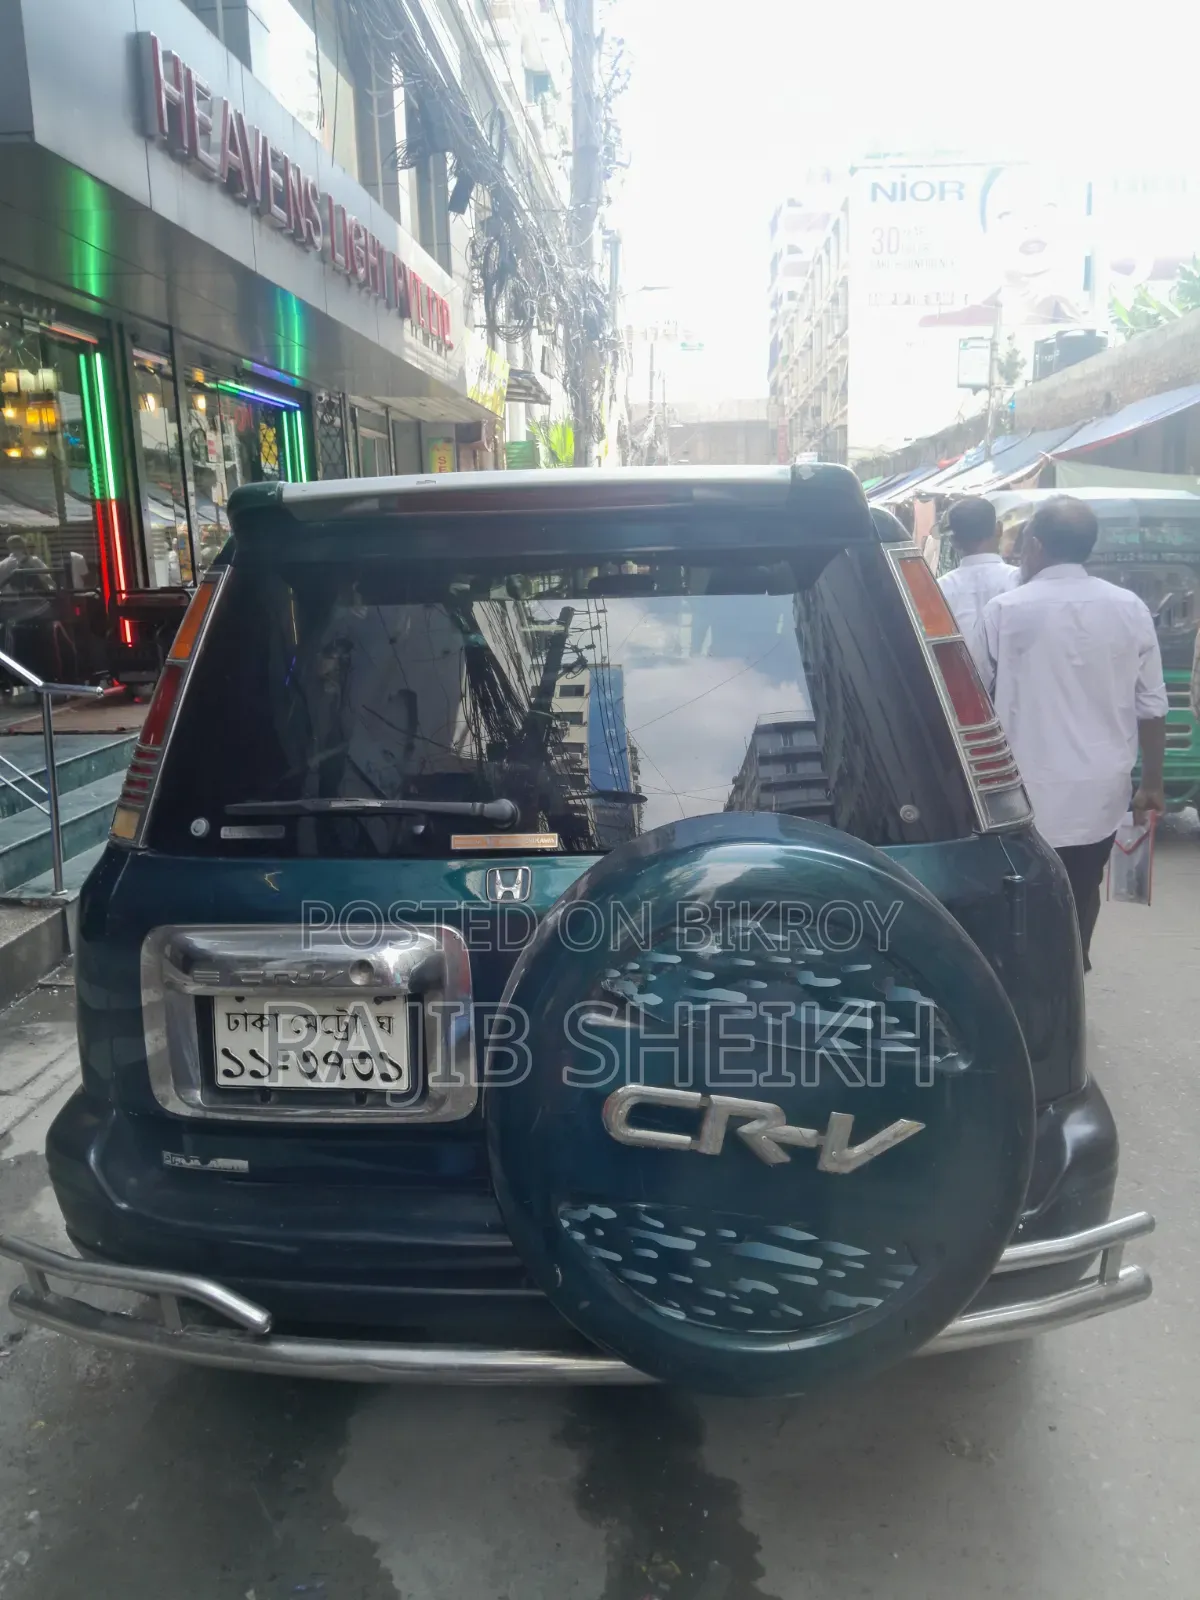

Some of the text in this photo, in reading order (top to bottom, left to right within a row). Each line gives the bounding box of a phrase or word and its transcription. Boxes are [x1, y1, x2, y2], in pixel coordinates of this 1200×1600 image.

[146, 31, 324, 252] HEAVENS
[326, 191, 389, 303] LIGHT
[871, 226, 900, 256] 30
[225, 1008, 280, 1033] ঢাকা
[376, 1014, 395, 1036] ঘ
